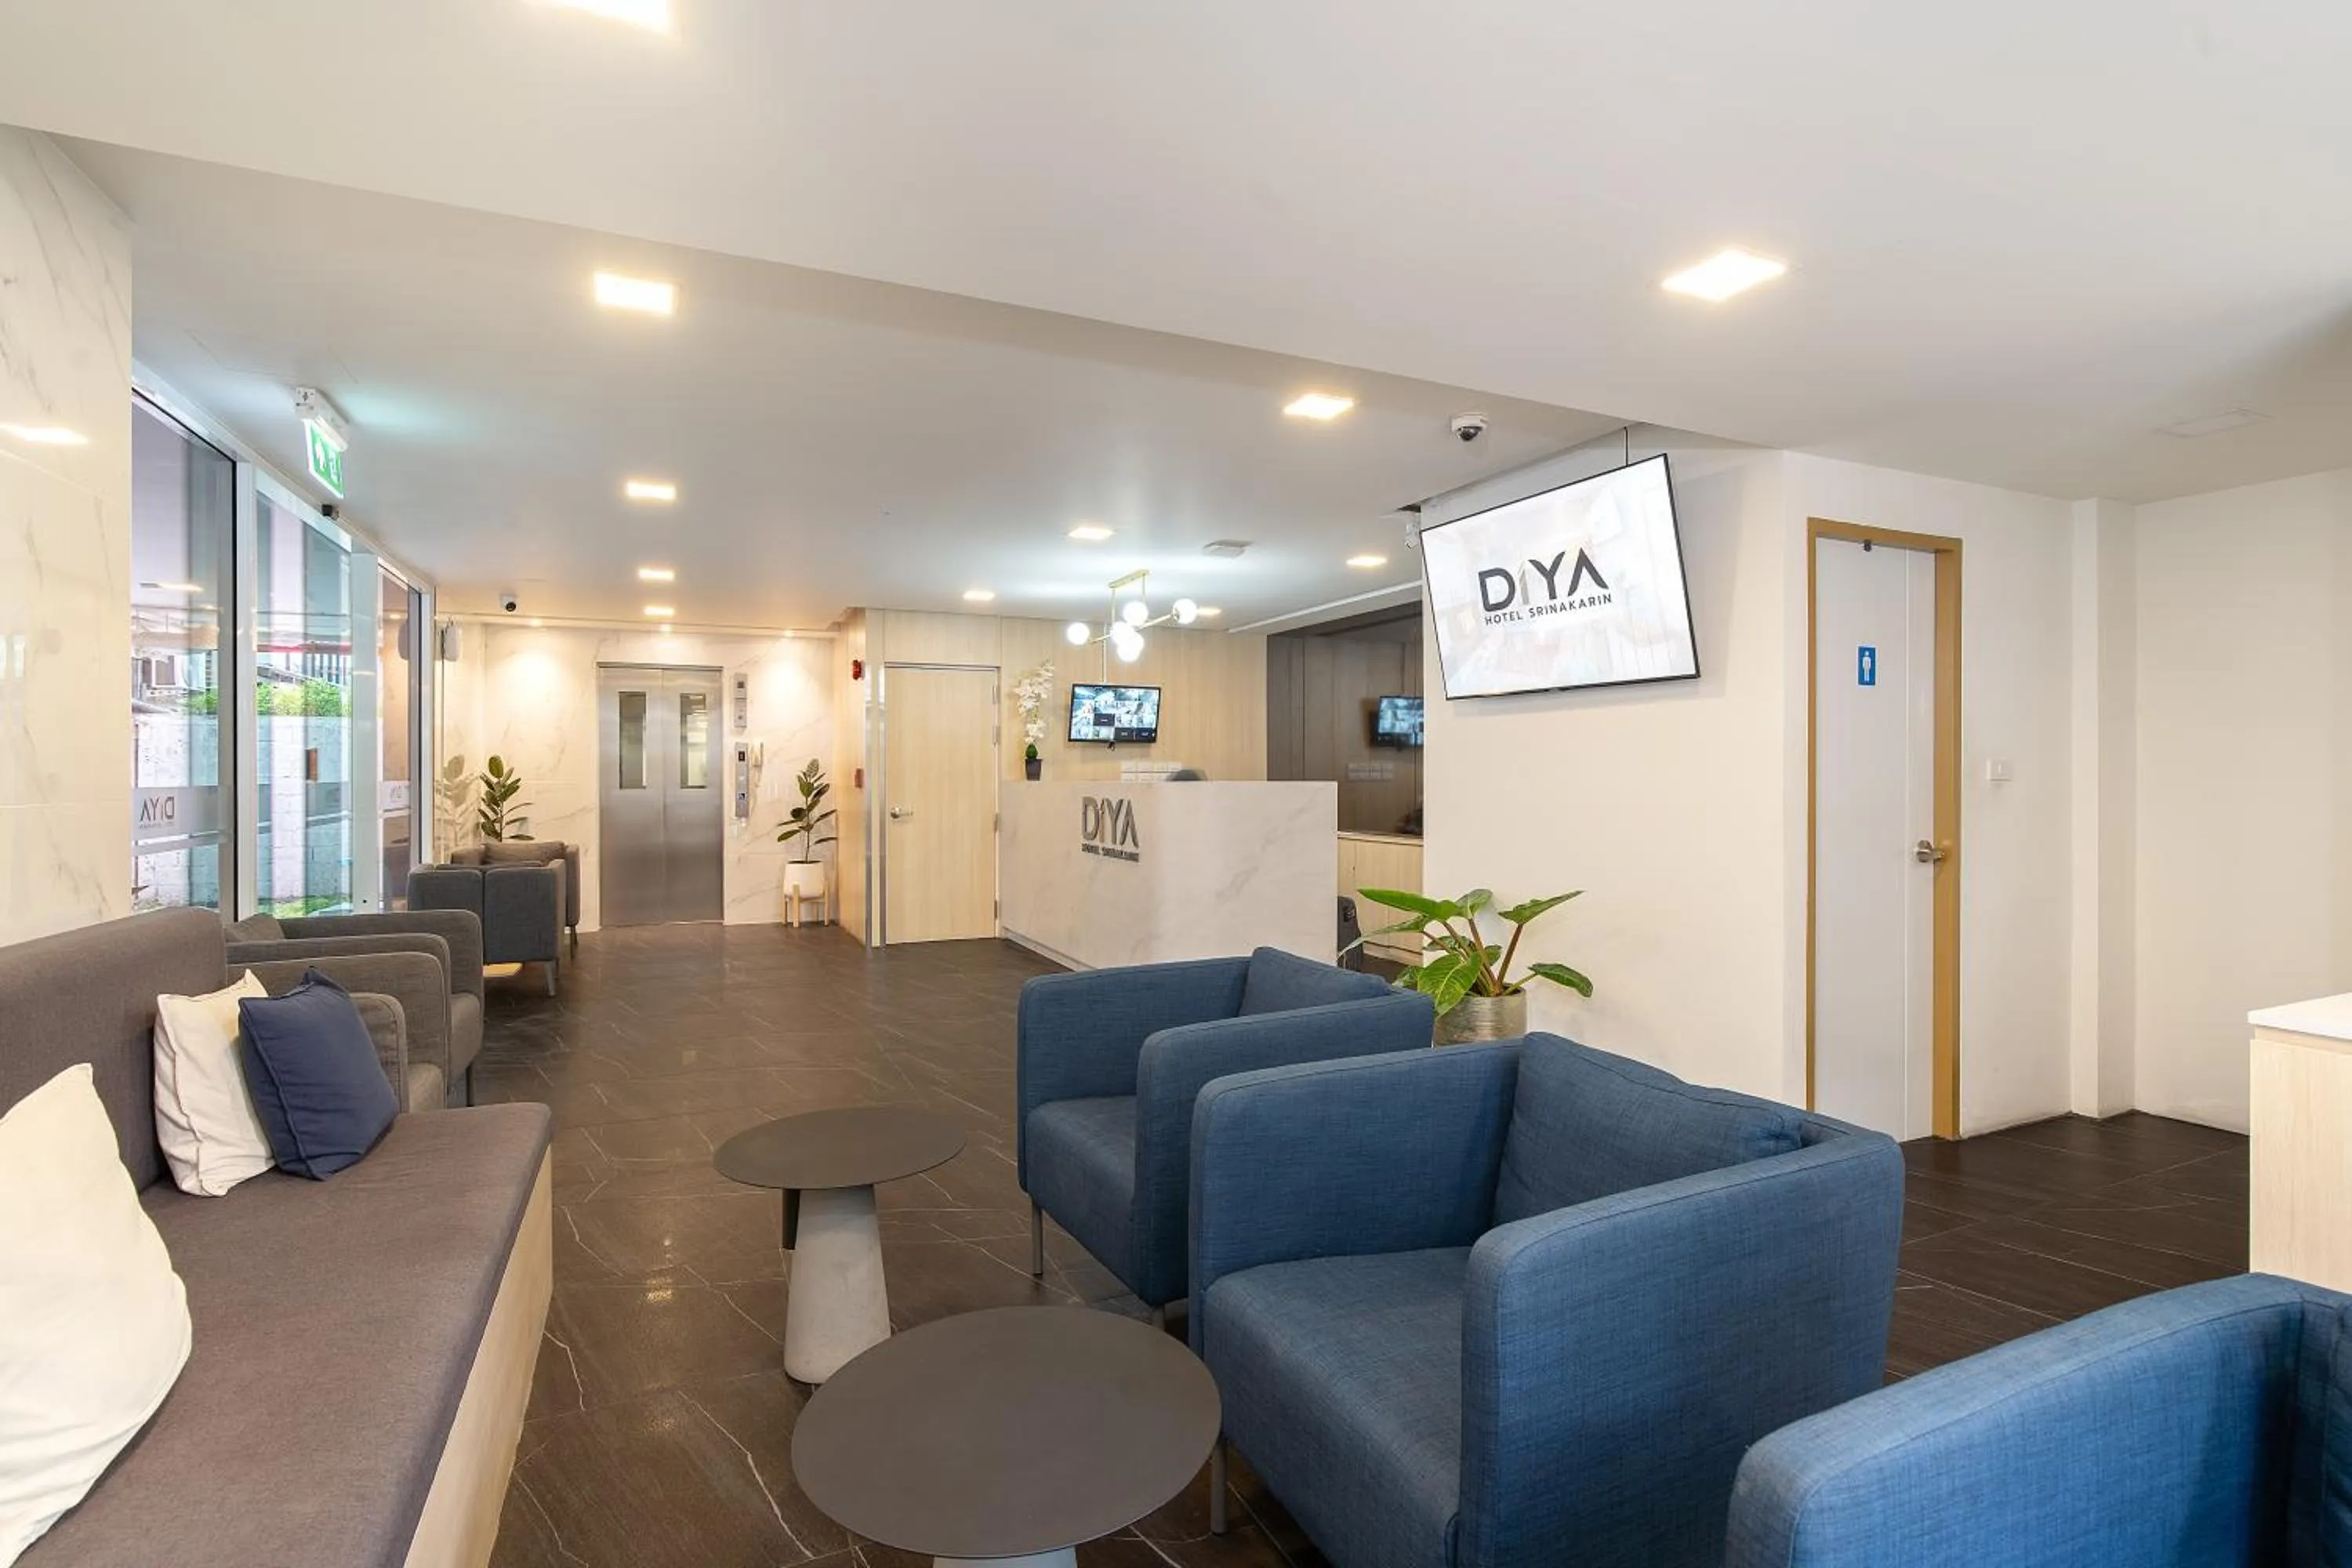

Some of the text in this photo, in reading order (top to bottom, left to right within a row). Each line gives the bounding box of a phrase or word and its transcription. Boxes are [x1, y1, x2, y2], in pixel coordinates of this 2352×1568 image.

[1478, 547, 1609, 612] DIYA
[1484, 593, 1612, 626] HOTEL SRINAKARIN
